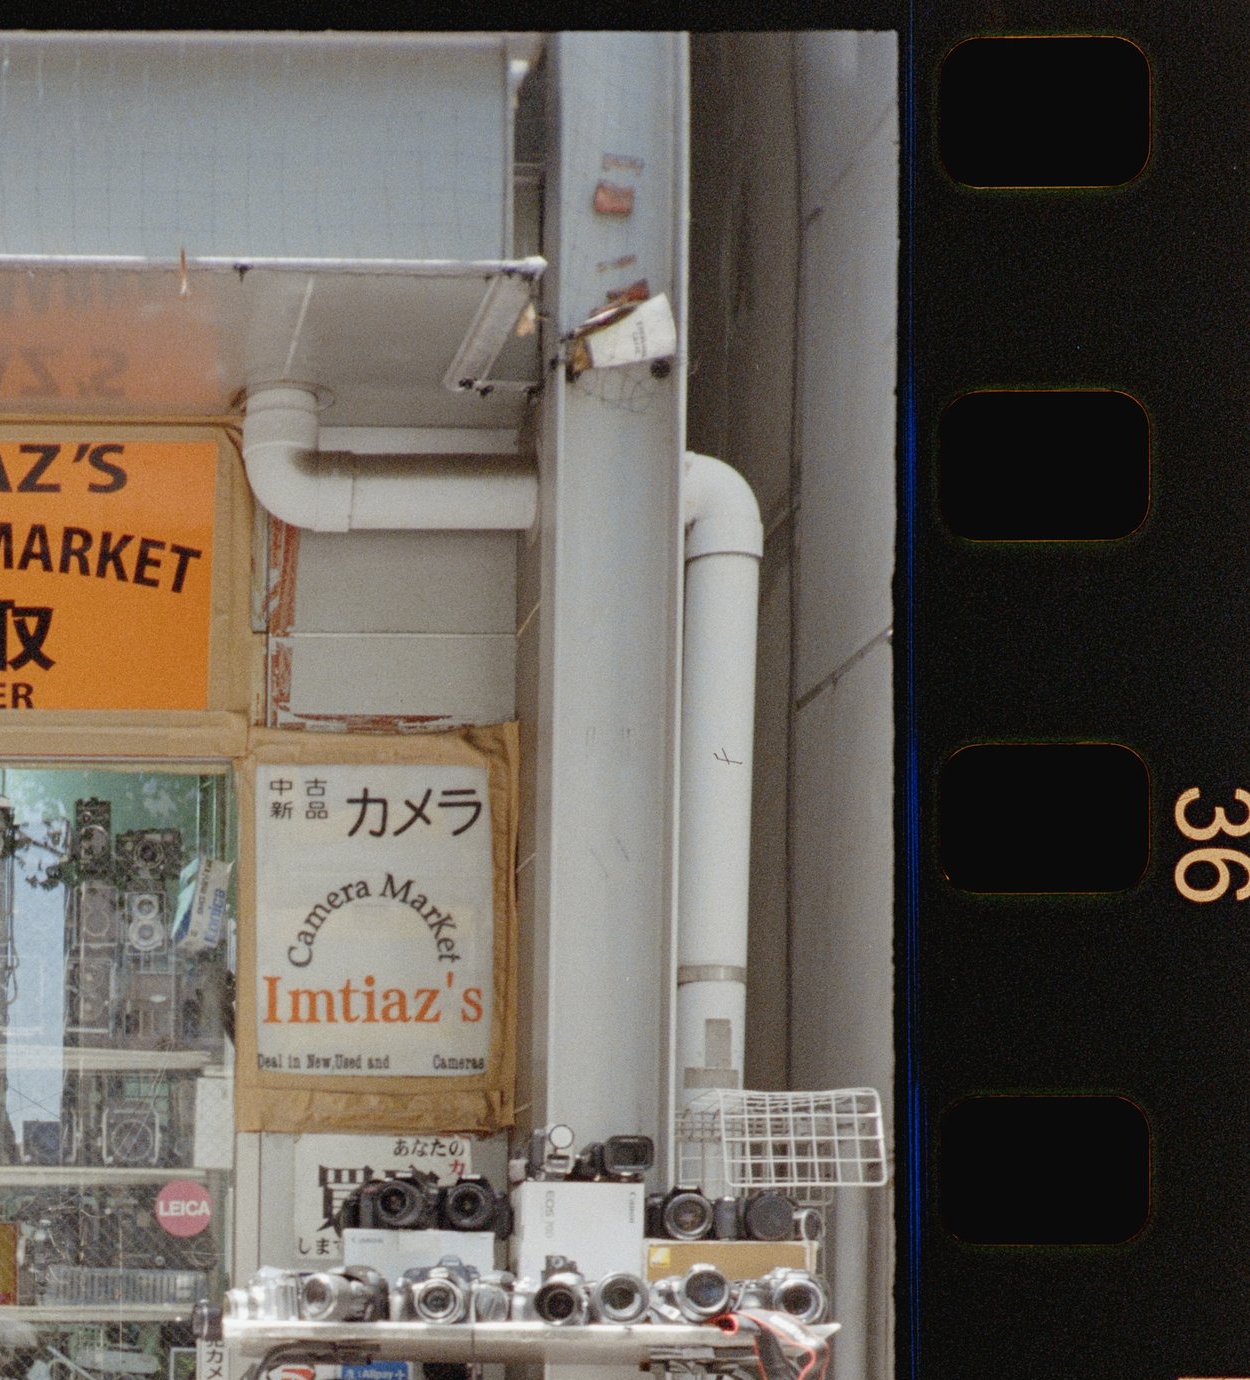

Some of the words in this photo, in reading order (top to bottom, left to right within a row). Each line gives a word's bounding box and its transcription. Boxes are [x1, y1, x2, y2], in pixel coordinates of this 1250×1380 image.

[346, 788, 483, 838] カメラ
[1175, 787, 1250, 902] 36
[287, 878, 372, 968] Camera
[262, 972, 484, 1024] Imtiaz's
[288, 1054, 300, 1069] in
[367, 1054, 390, 1069] and
[433, 1054, 485, 1070] Cameras
[393, 1139, 465, 1157] あなたの
[158, 1200, 211, 1217] LEICA
